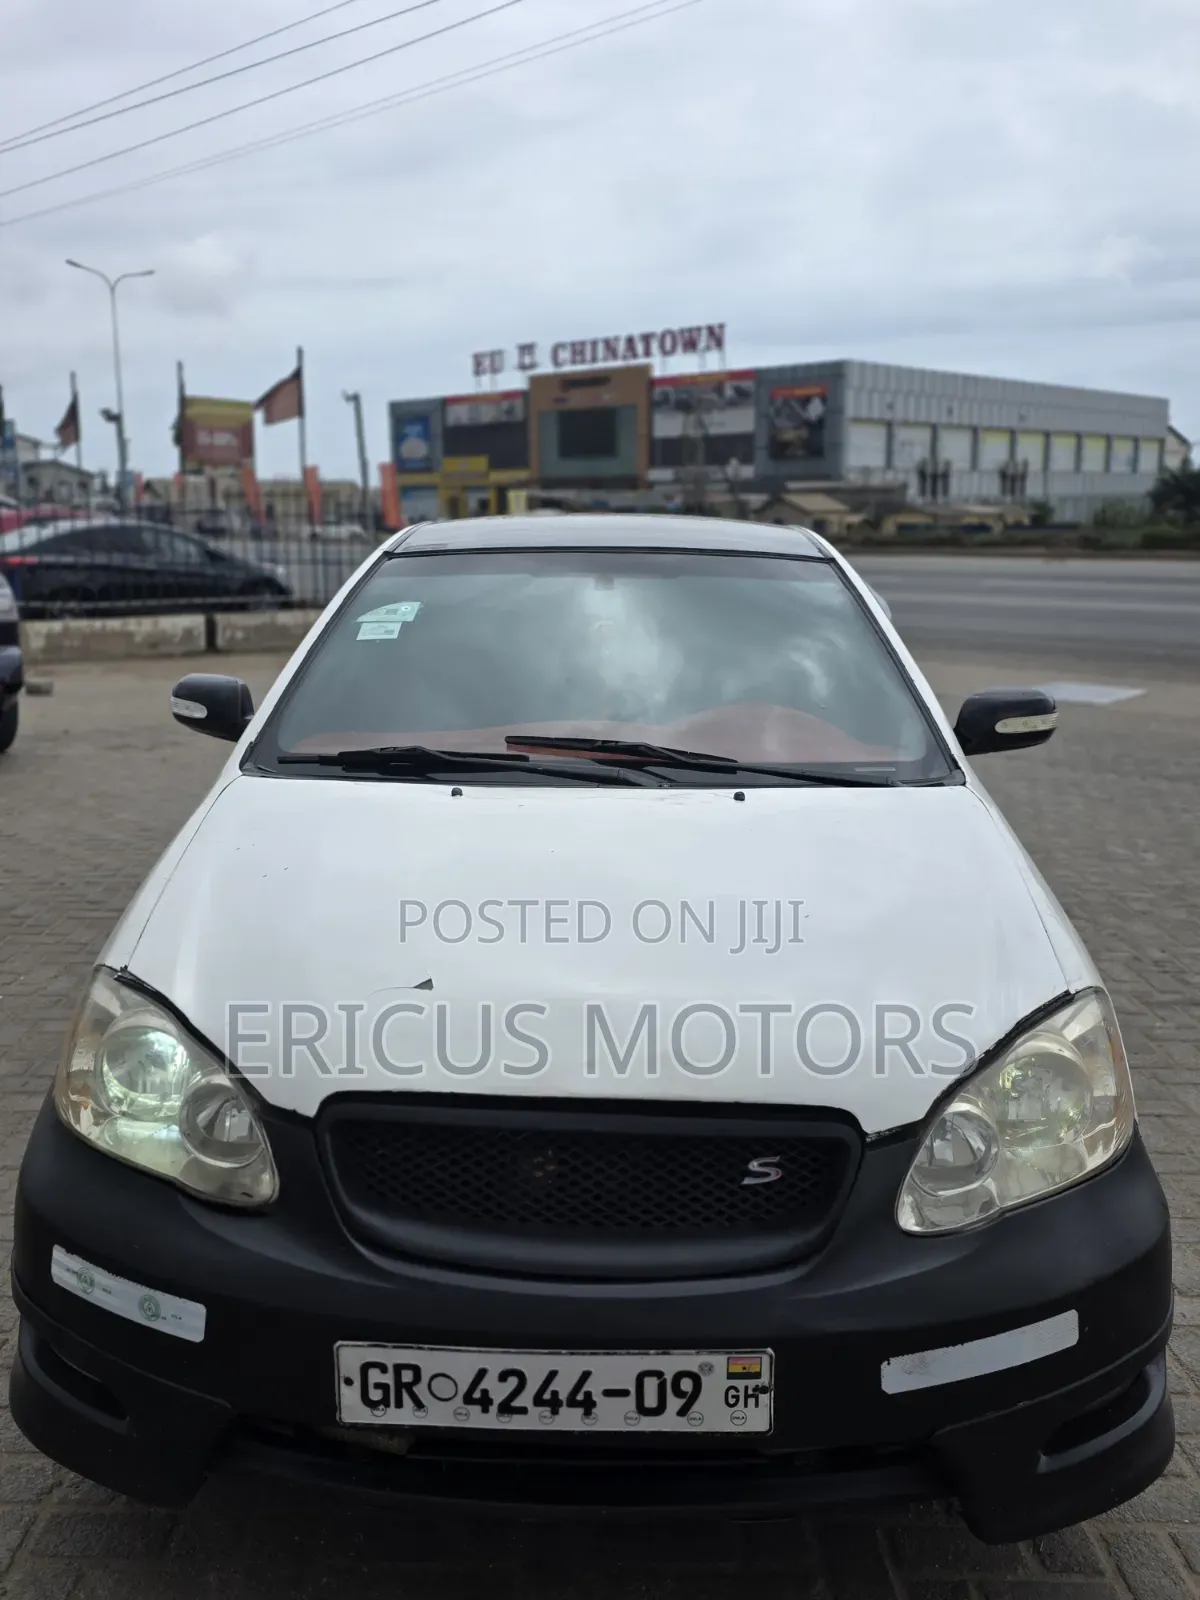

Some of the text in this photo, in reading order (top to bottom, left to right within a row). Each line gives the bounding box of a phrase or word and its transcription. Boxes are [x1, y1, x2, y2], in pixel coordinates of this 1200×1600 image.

[551, 322, 726, 368] CHINATOWN
[740, 1155, 782, 1185] S
[359, 1360, 703, 1418] GR 4244-09
[723, 1384, 760, 1409] GH
